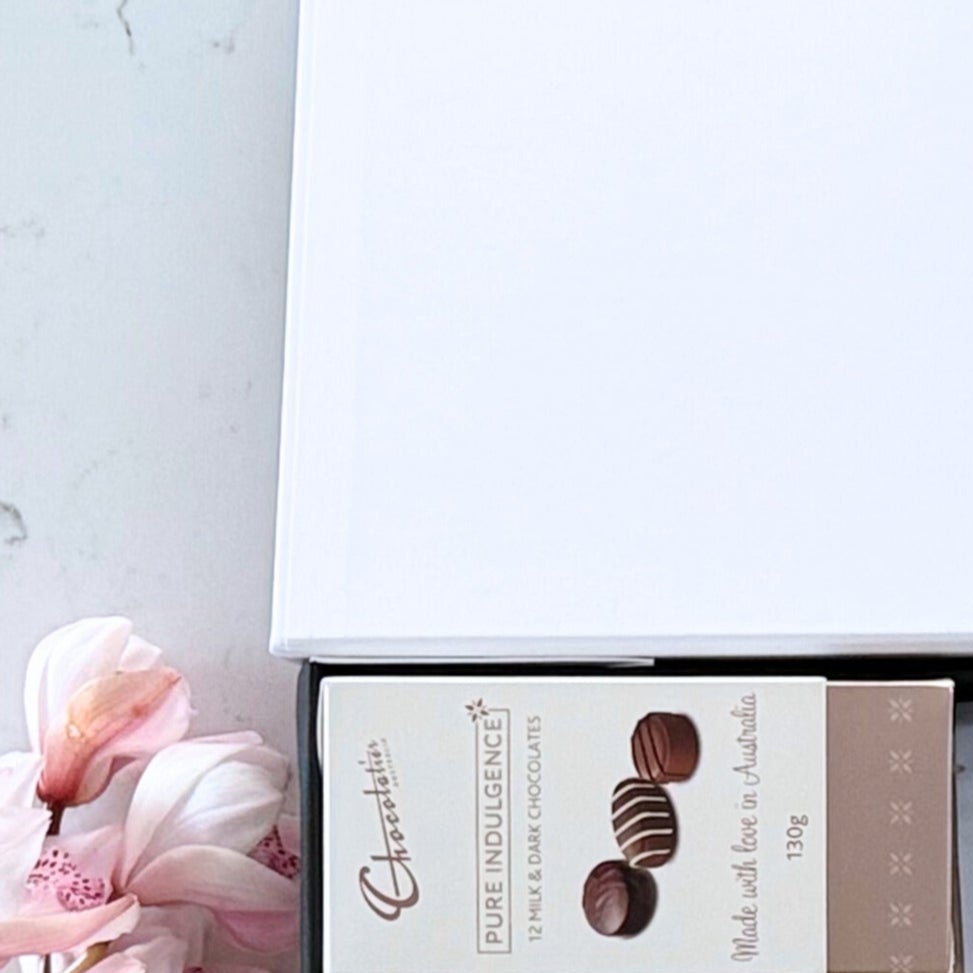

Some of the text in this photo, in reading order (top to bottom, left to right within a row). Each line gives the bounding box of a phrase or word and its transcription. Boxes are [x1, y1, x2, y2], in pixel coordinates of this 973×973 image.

[358, 739, 419, 921] Chocolatier
[485, 718, 503, 944] PURE INDULGENCE
[527, 715, 542, 941] 12 MILK & DARK CHOCOLATES
[730, 693, 760, 962] Made with love in Australia
[786, 814, 809, 860] 130g
